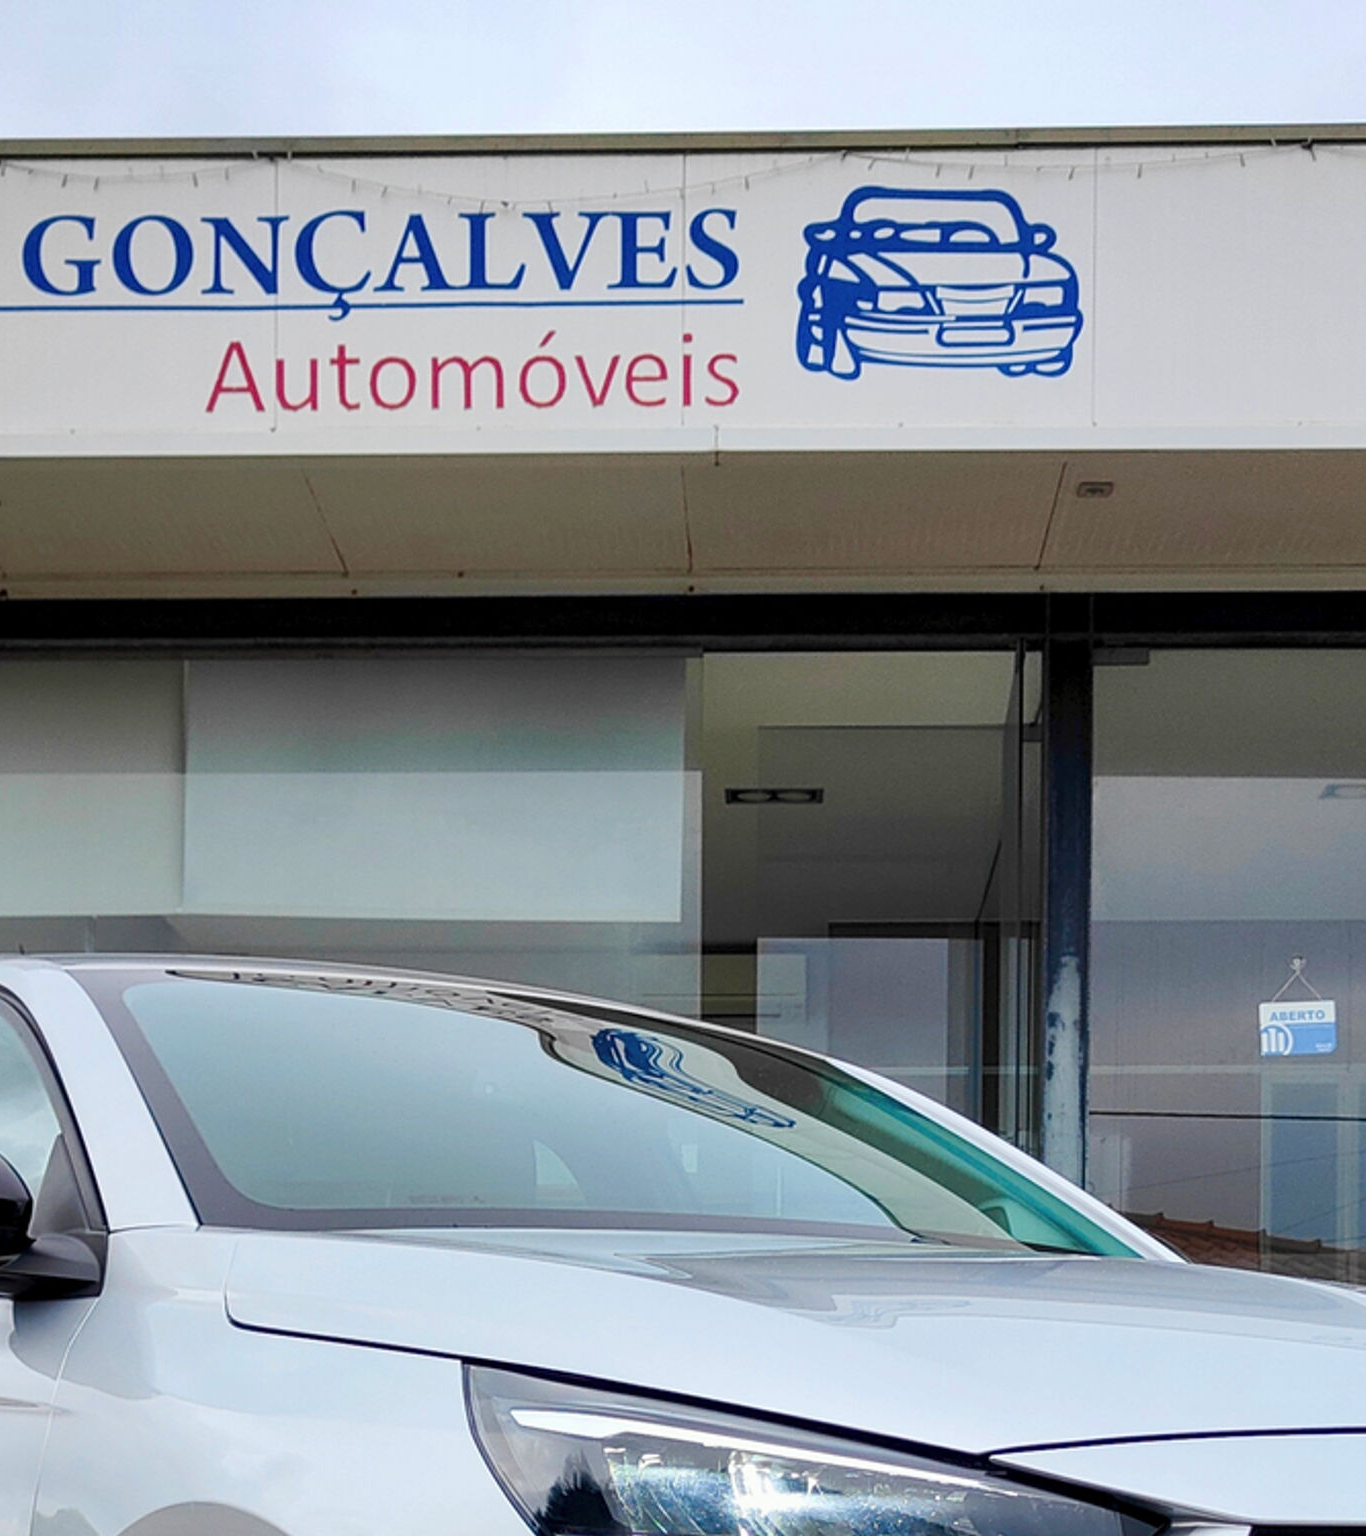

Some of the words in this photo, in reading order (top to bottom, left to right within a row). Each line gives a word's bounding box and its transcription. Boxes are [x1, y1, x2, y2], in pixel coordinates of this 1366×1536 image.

[21, 208, 740, 321] GONÇALVES
[205, 331, 740, 414] Automóveis
[1269, 1009, 1325, 1021] ABERTO
